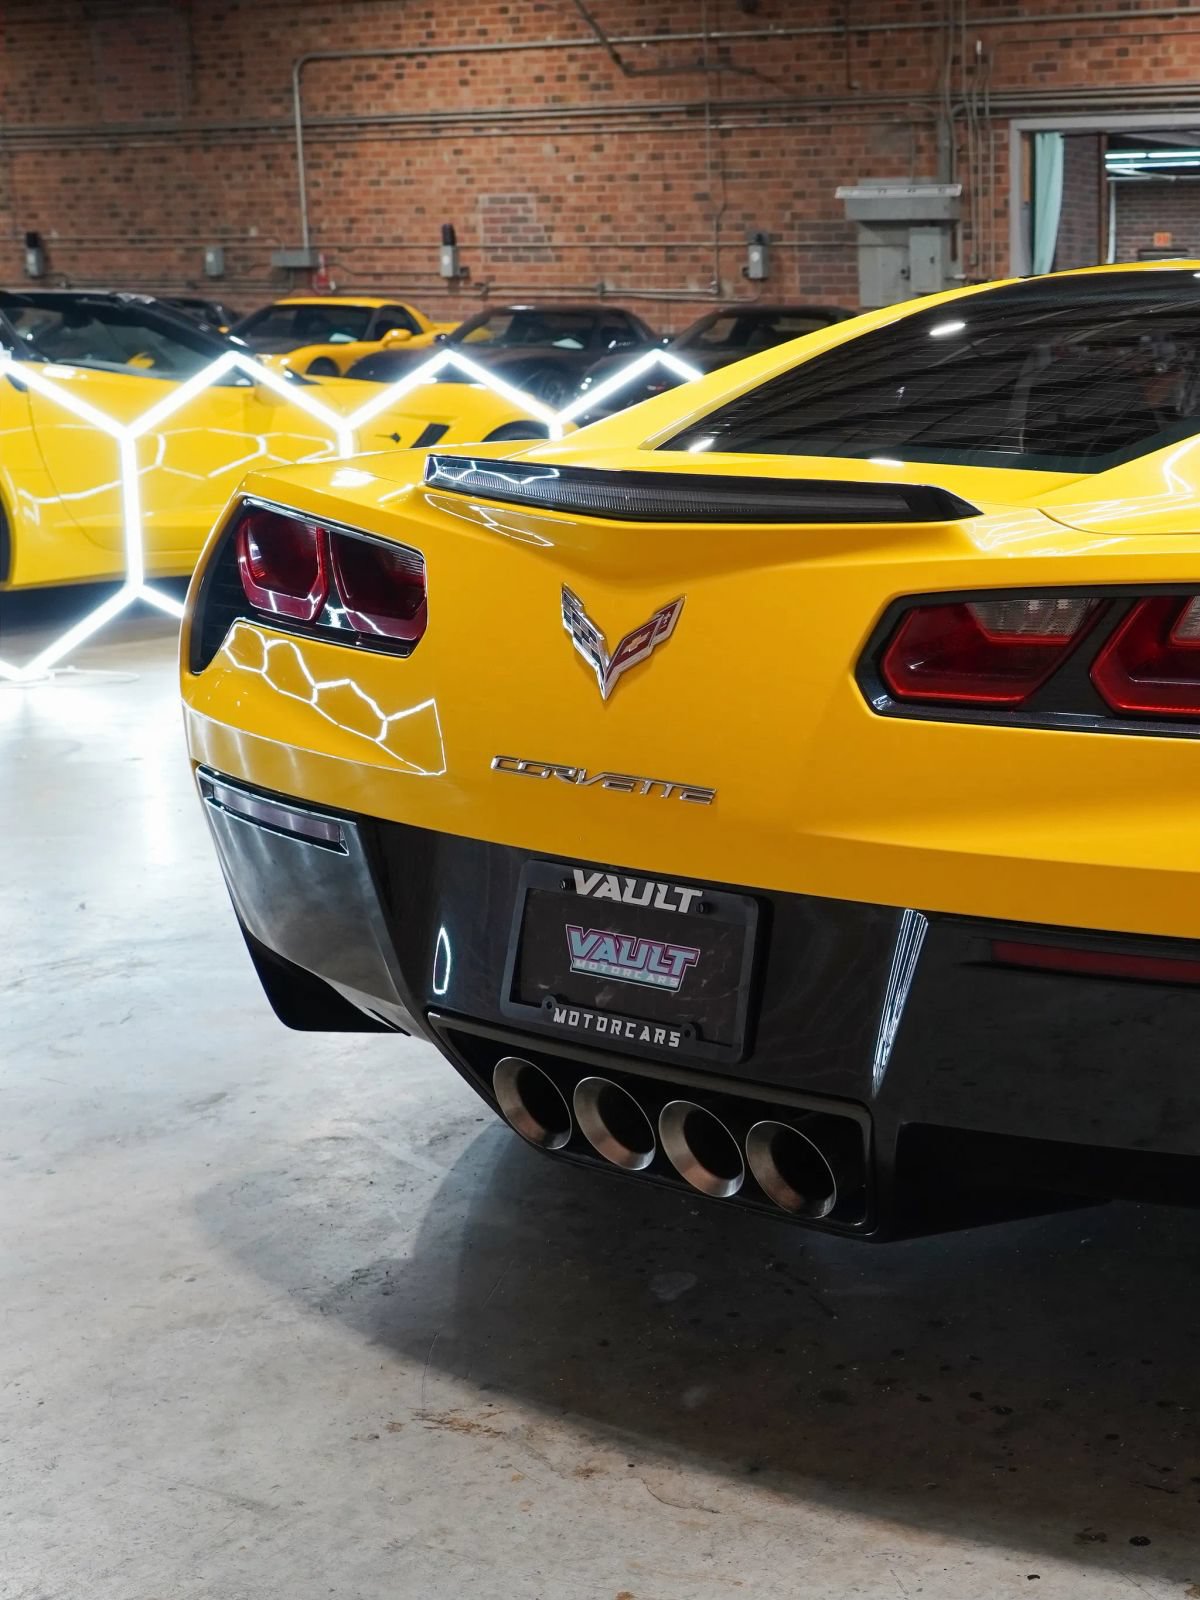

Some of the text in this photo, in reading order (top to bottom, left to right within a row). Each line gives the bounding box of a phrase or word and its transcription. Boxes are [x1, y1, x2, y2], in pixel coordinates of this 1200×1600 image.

[490, 755, 717, 805] CORVETTE
[572, 869, 703, 914] VAULT
[569, 929, 697, 977] VAULT
[573, 958, 682, 989] MOTORCARS
[553, 1007, 681, 1048] MOTORCARS
